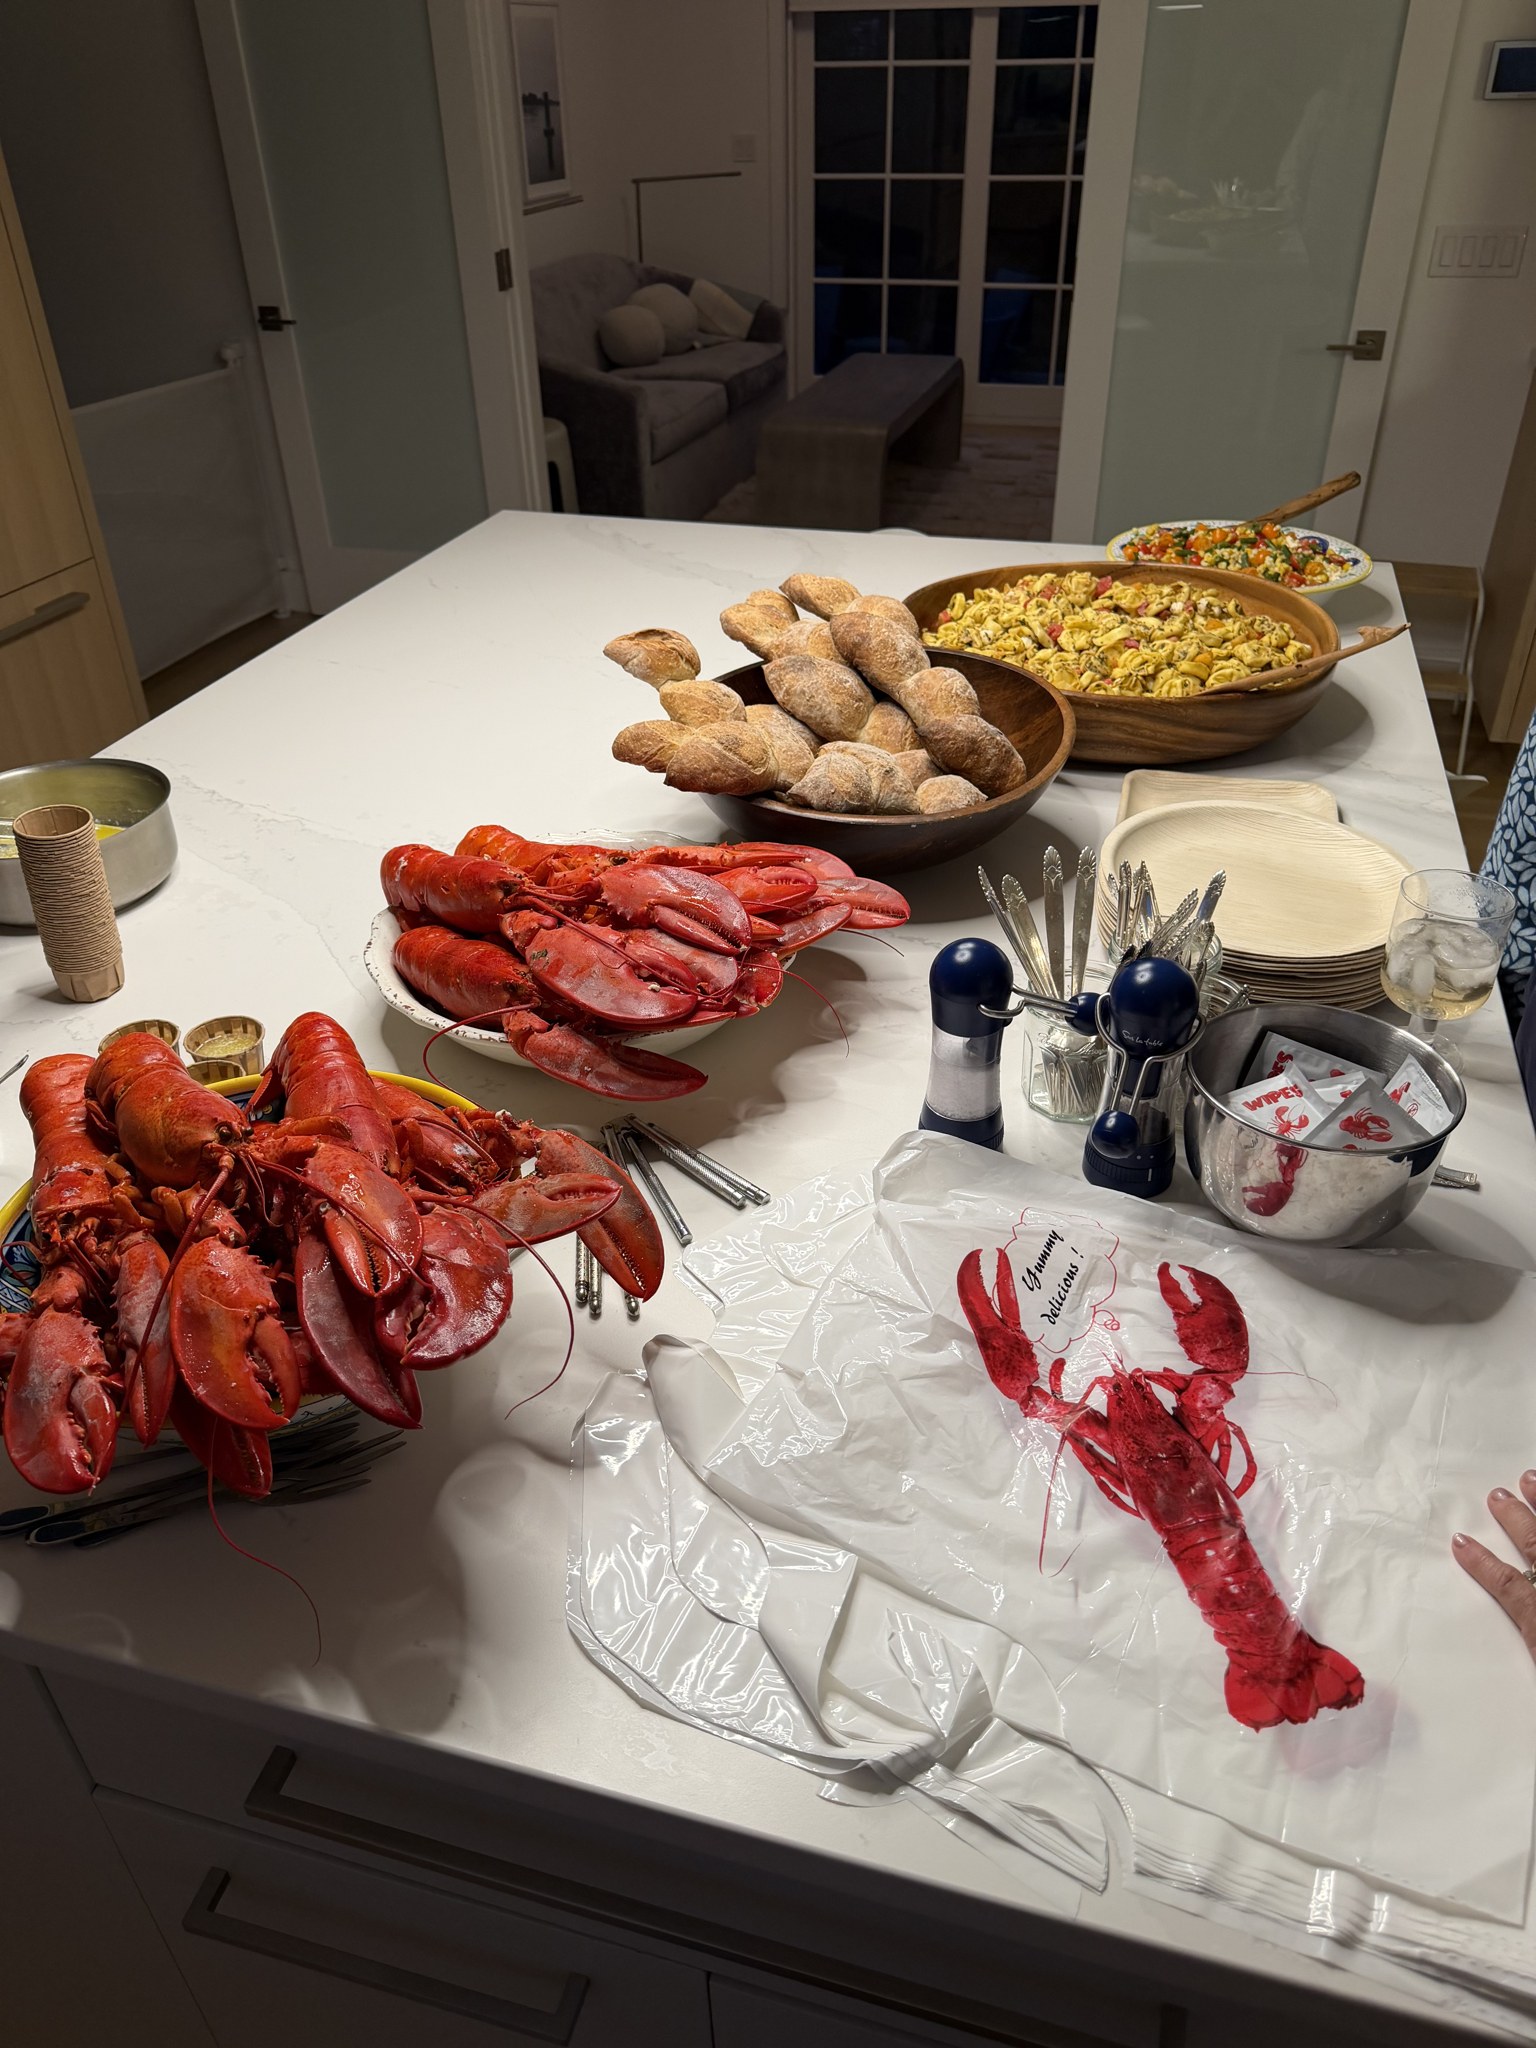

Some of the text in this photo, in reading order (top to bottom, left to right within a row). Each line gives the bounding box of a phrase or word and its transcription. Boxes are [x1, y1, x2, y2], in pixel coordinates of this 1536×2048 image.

[1241, 1083, 1304, 1112] WIPES
[1021, 1229, 1065, 1292] Yummy
[1040, 1262, 1080, 1325] delicious
